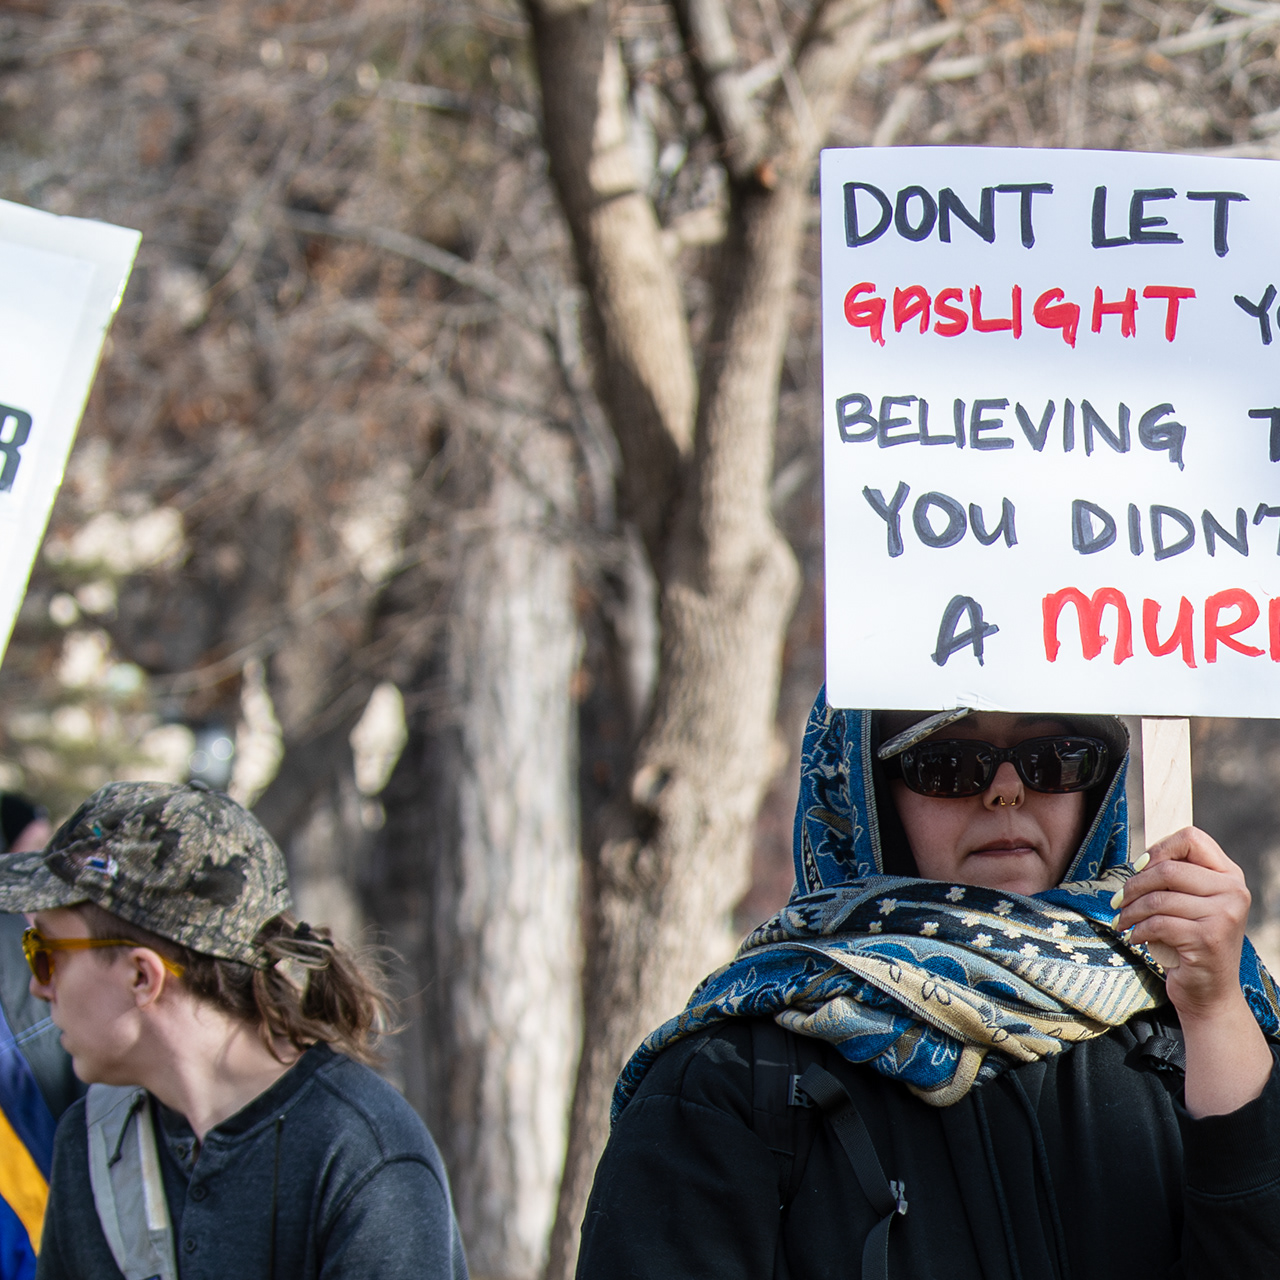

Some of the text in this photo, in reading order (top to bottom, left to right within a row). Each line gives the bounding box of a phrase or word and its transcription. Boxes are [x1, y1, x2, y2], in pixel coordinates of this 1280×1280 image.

[842, 181, 1055, 250] DONT
[1090, 185, 1250, 258] LET
[843, 281, 1197, 350] GASLIGHT
[835, 392, 1187, 472] BELIEVING
[861, 480, 1019, 558] YOU
[930, 594, 1000, 667] A
